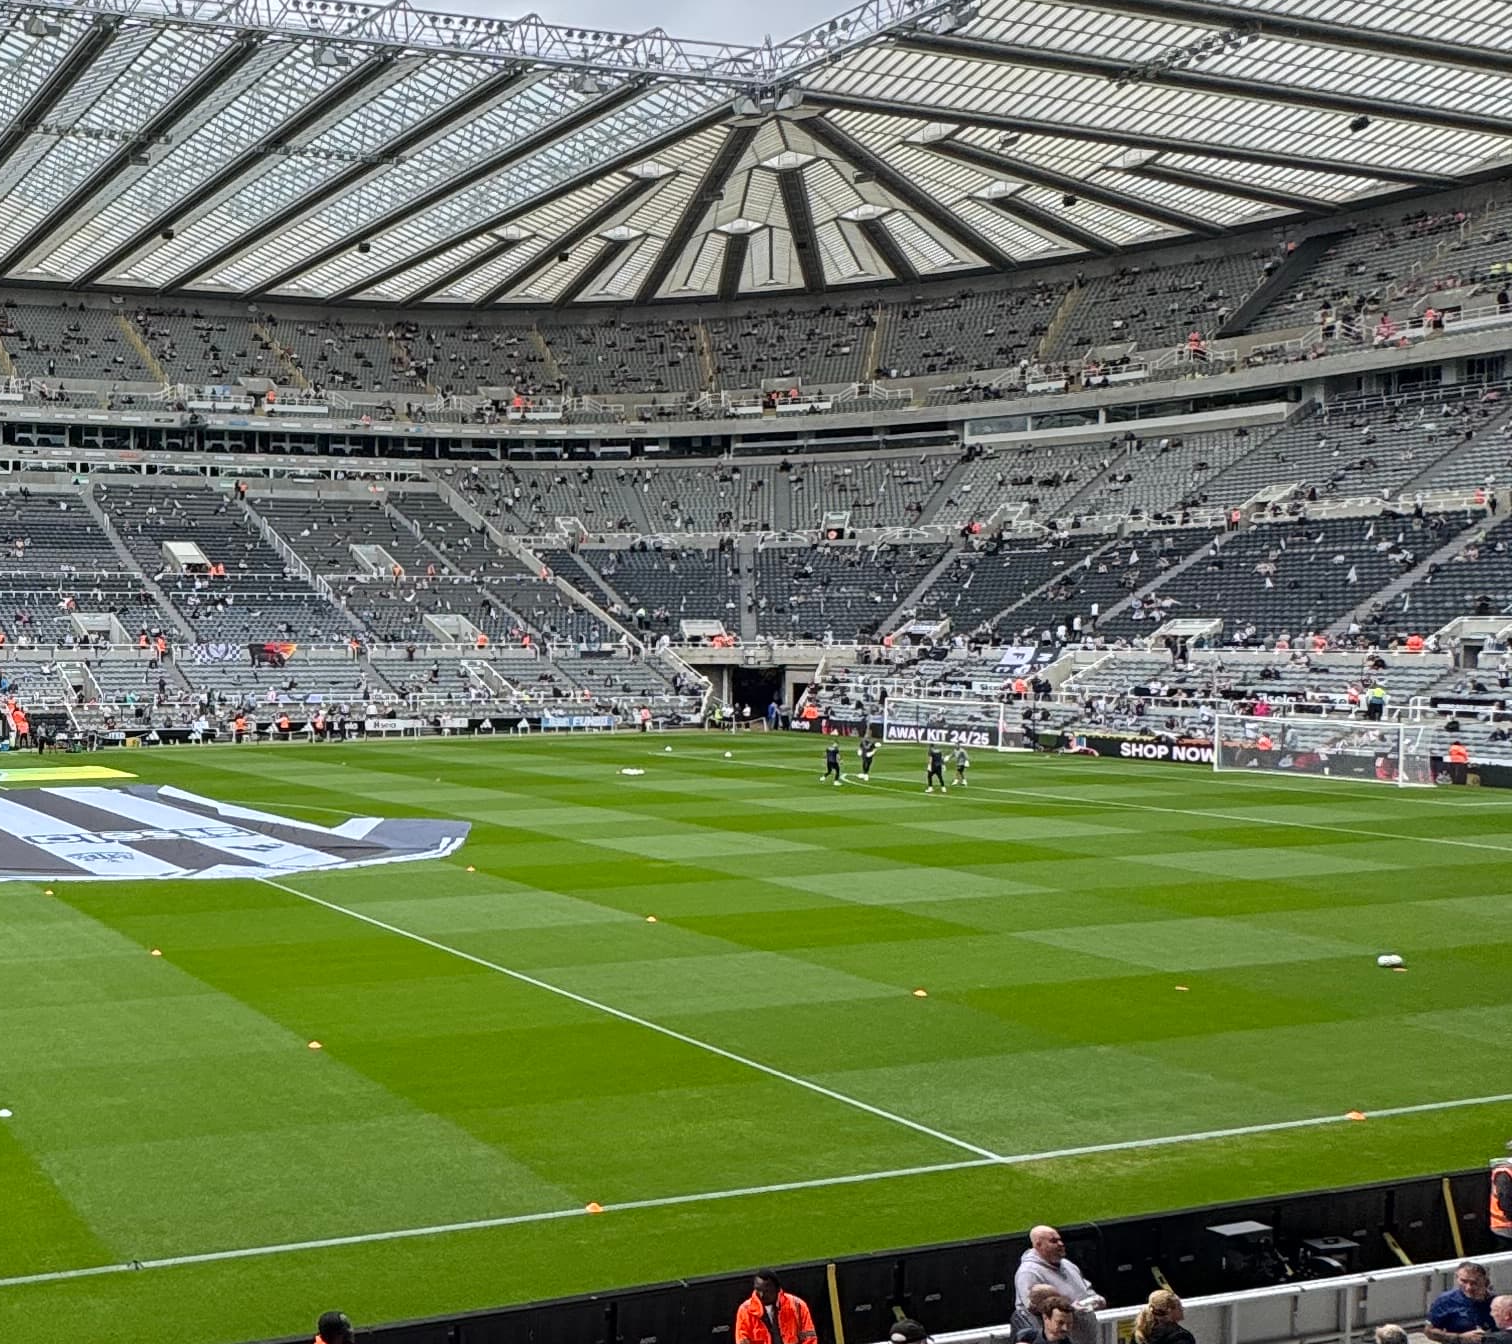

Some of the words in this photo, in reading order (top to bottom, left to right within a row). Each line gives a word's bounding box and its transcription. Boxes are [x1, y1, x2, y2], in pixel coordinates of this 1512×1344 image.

[888, 726, 925, 740] AWAY
[927, 728, 948, 741] KIT
[950, 730, 989, 745] 24/25
[1120, 742, 1169, 759] SHOP
[1172, 745, 1214, 762] NOW
